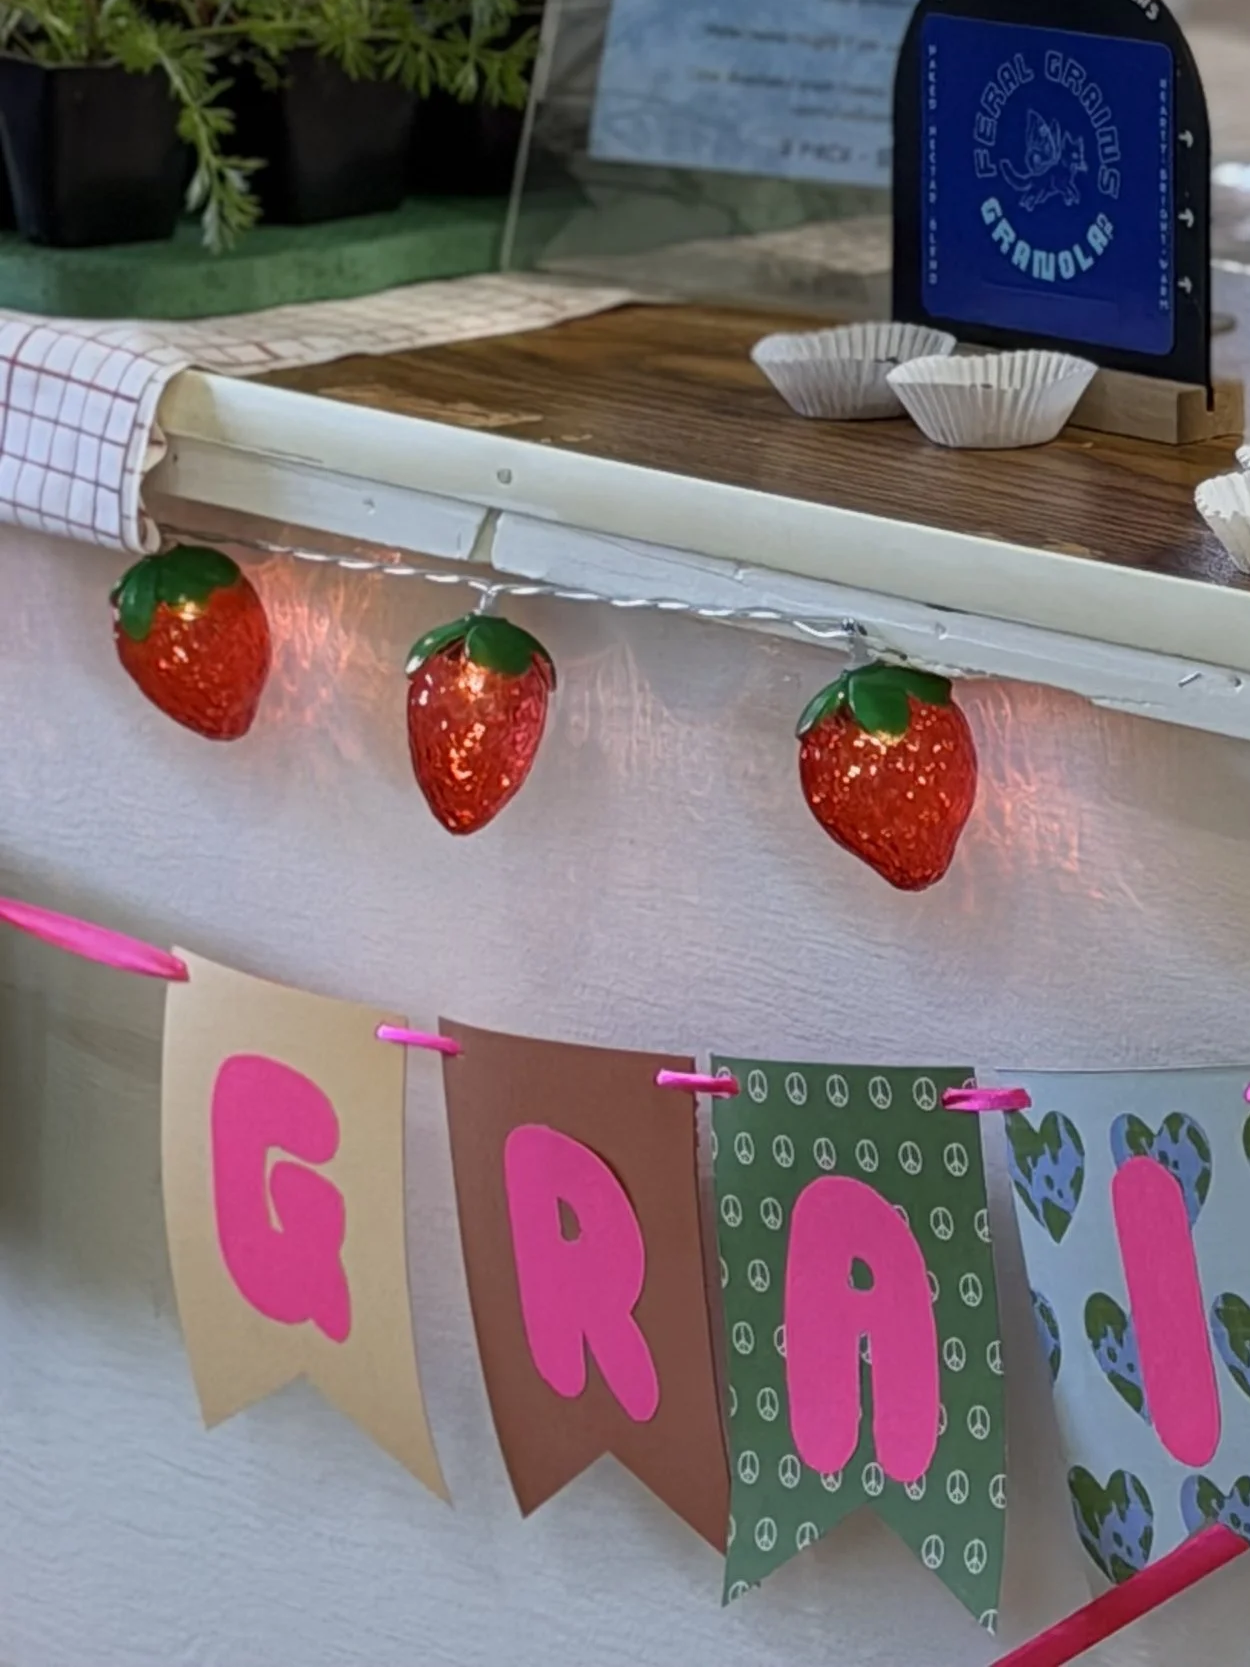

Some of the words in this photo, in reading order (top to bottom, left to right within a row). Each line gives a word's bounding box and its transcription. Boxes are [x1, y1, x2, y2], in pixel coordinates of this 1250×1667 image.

[973, 52, 1035, 179] FERAL
[1044, 49, 1122, 200] GRAINS
[980, 196, 1109, 283] GRANOLA
